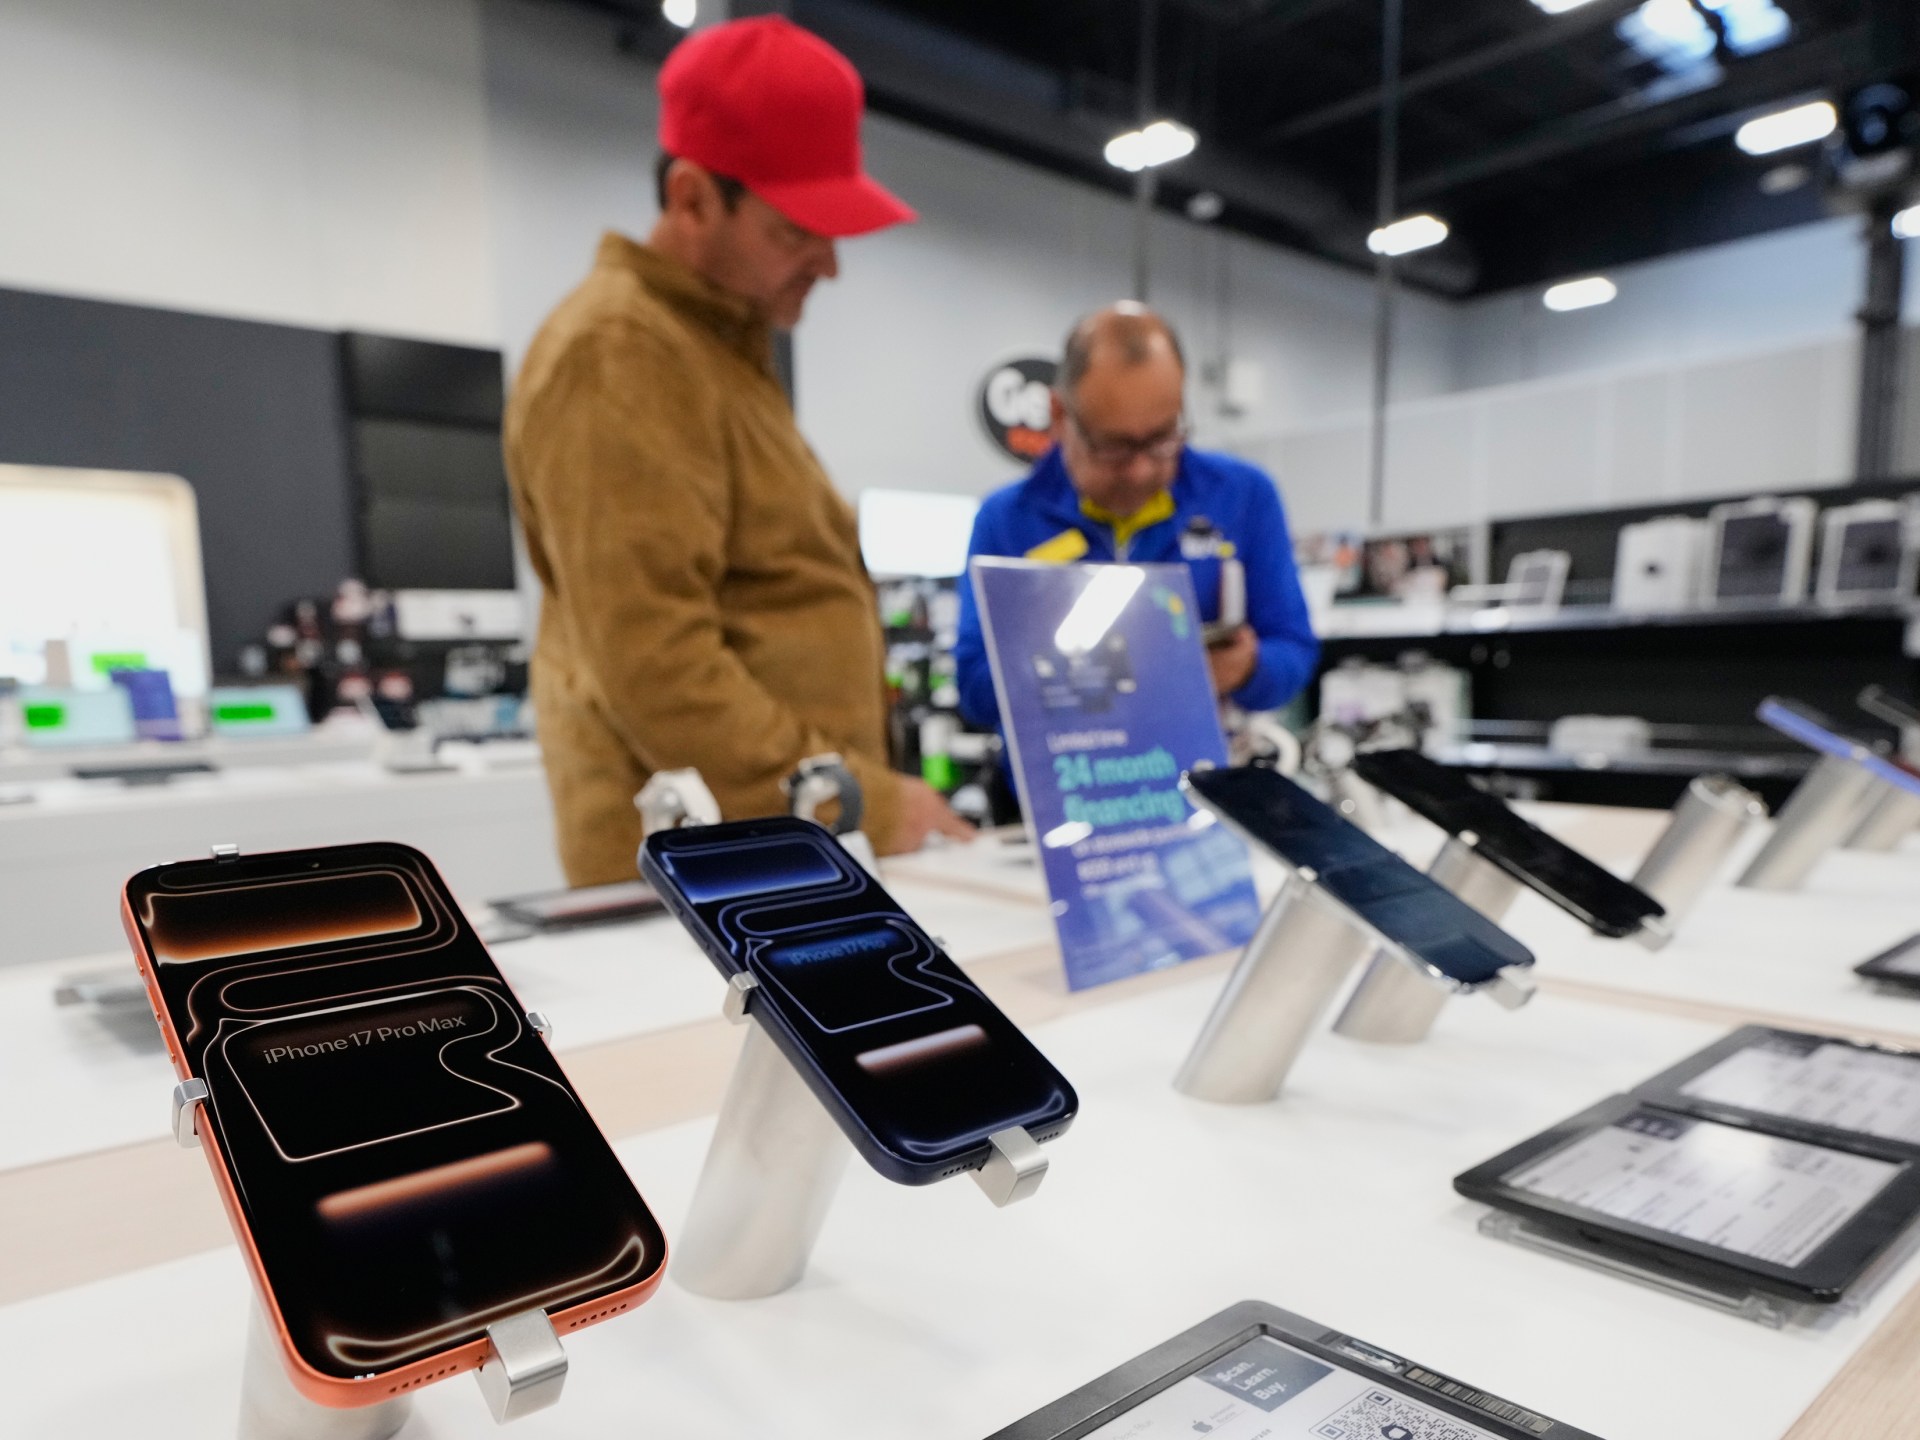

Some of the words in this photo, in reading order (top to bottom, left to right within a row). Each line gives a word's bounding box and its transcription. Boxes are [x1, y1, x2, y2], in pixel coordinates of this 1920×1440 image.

[1052, 752, 1093, 791] 24
[1094, 745, 1177, 785] month
[1063, 785, 1185, 828] financing
[788, 946, 844, 966] iPhone
[858, 937, 887, 952] Pro
[263, 1037, 349, 1065] iPhone
[349, 1029, 373, 1047] 17
[376, 1024, 417, 1042] Pro
[417, 1015, 468, 1034] Max
[1215, 1360, 1256, 1383] Scan.
[1232, 1367, 1279, 1392] Learn.
[1251, 1381, 1288, 1401] Buy.
